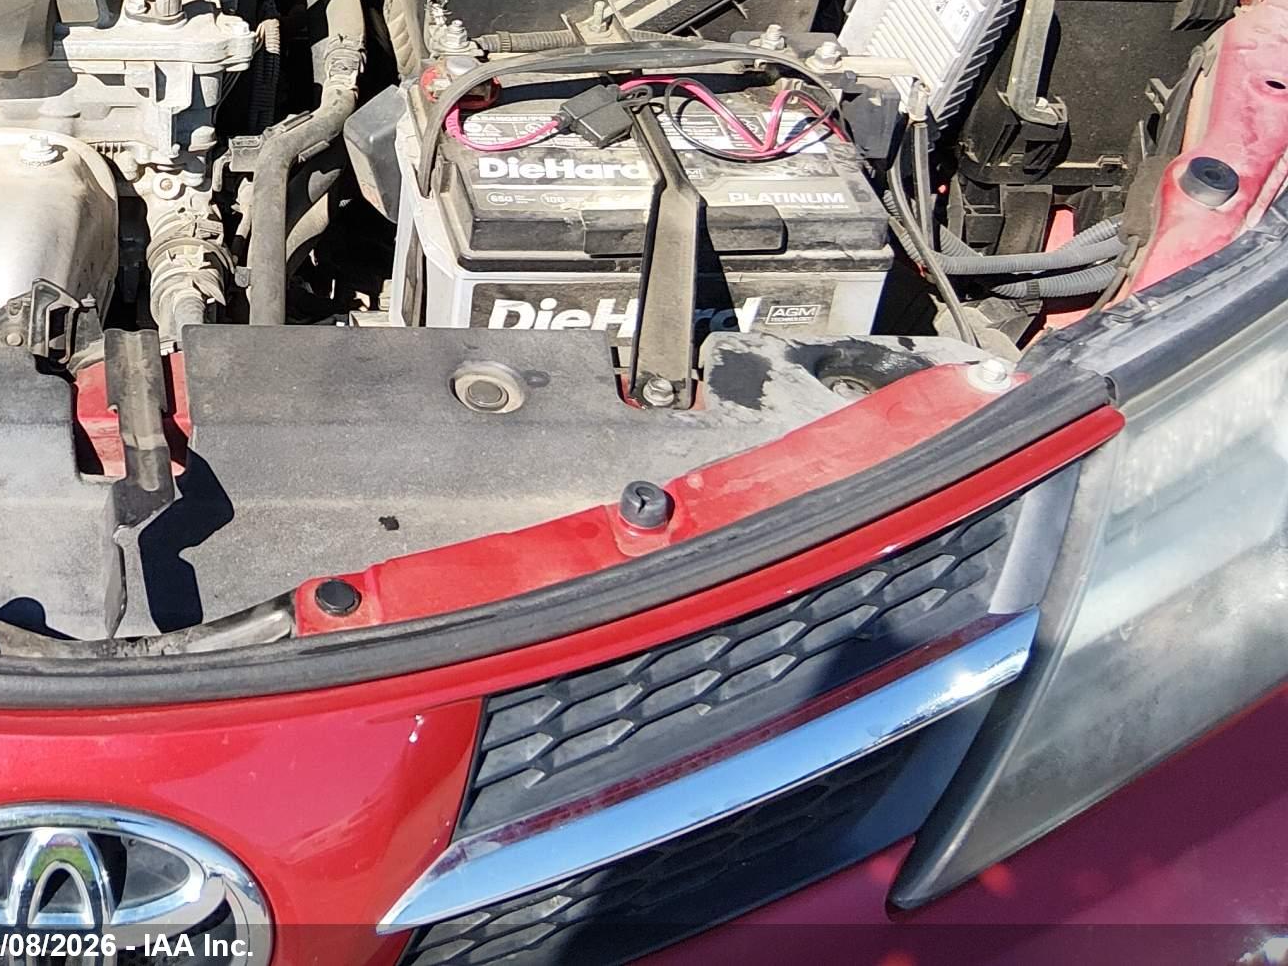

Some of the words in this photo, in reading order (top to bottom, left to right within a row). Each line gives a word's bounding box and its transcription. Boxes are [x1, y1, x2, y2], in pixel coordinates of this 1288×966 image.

[479, 157, 649, 179] DieHard
[728, 192, 846, 204] PLATINUM
[772, 307, 817, 317] AGM
